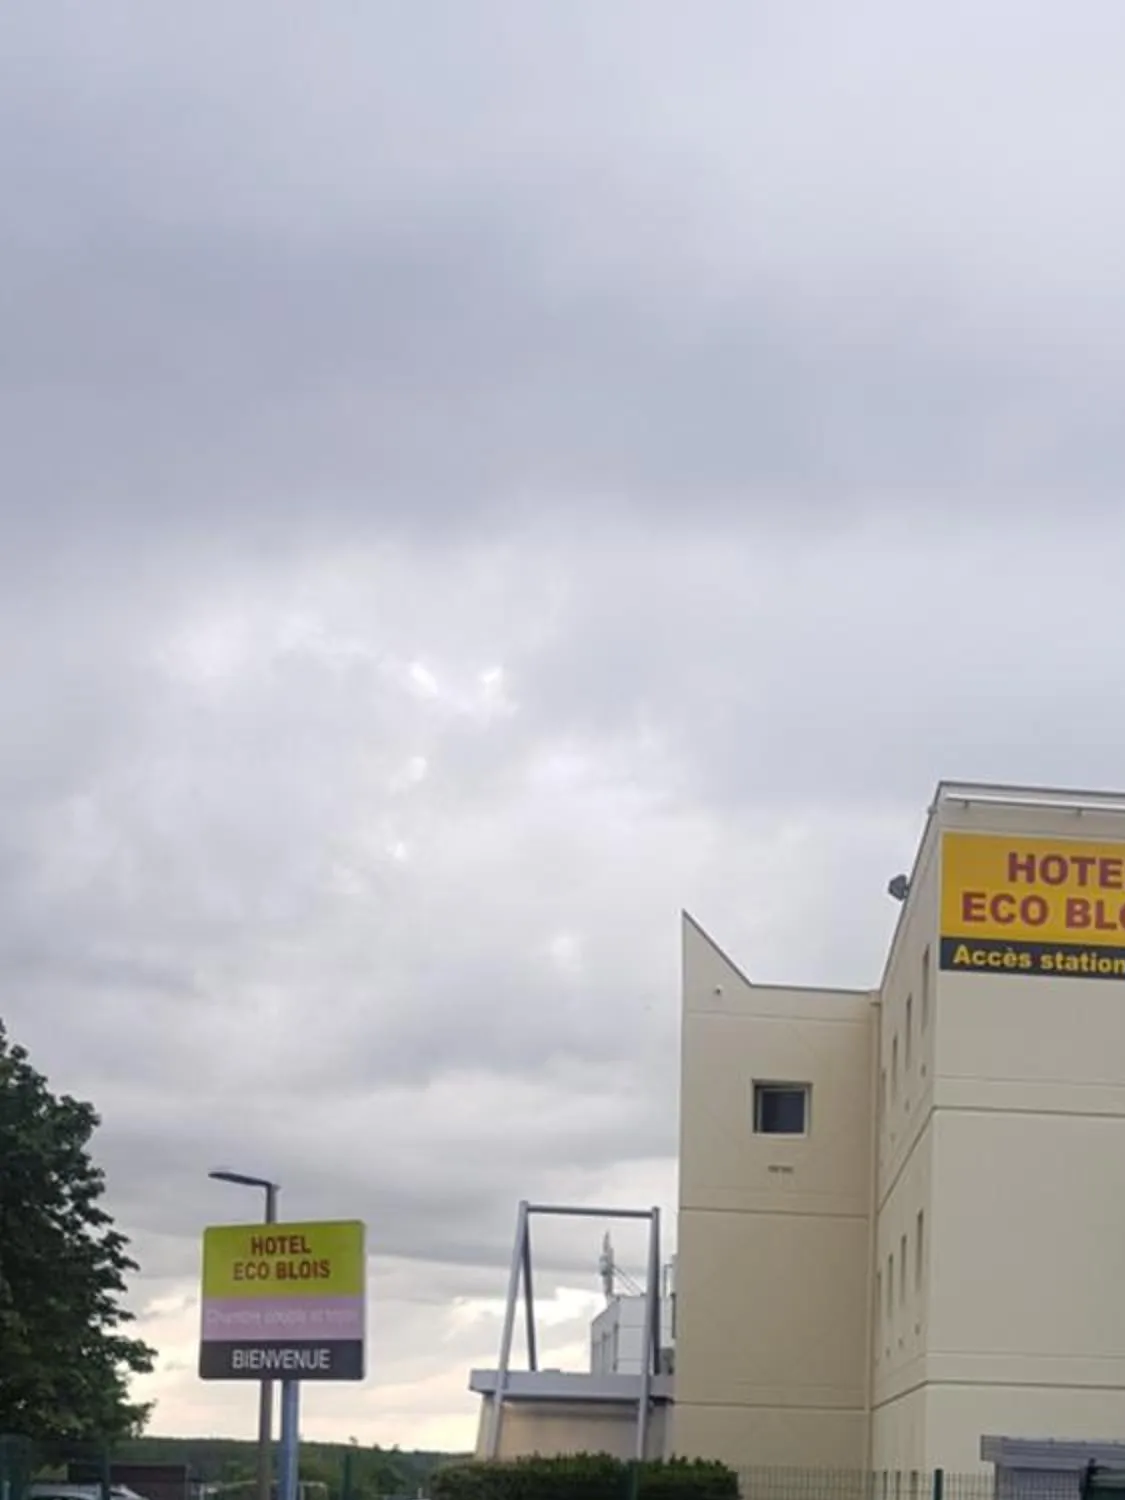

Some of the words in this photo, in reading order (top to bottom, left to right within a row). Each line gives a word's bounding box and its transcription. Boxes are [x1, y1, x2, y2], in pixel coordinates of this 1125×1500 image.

[961, 892, 1048, 927] ECO
[953, 944, 1032, 969] Accès
[251, 1236, 312, 1256] HOTEL
[233, 1262, 270, 1281] ECO
[276, 1260, 331, 1281] BLOIS
[232, 1349, 332, 1370] BIENVENUE
